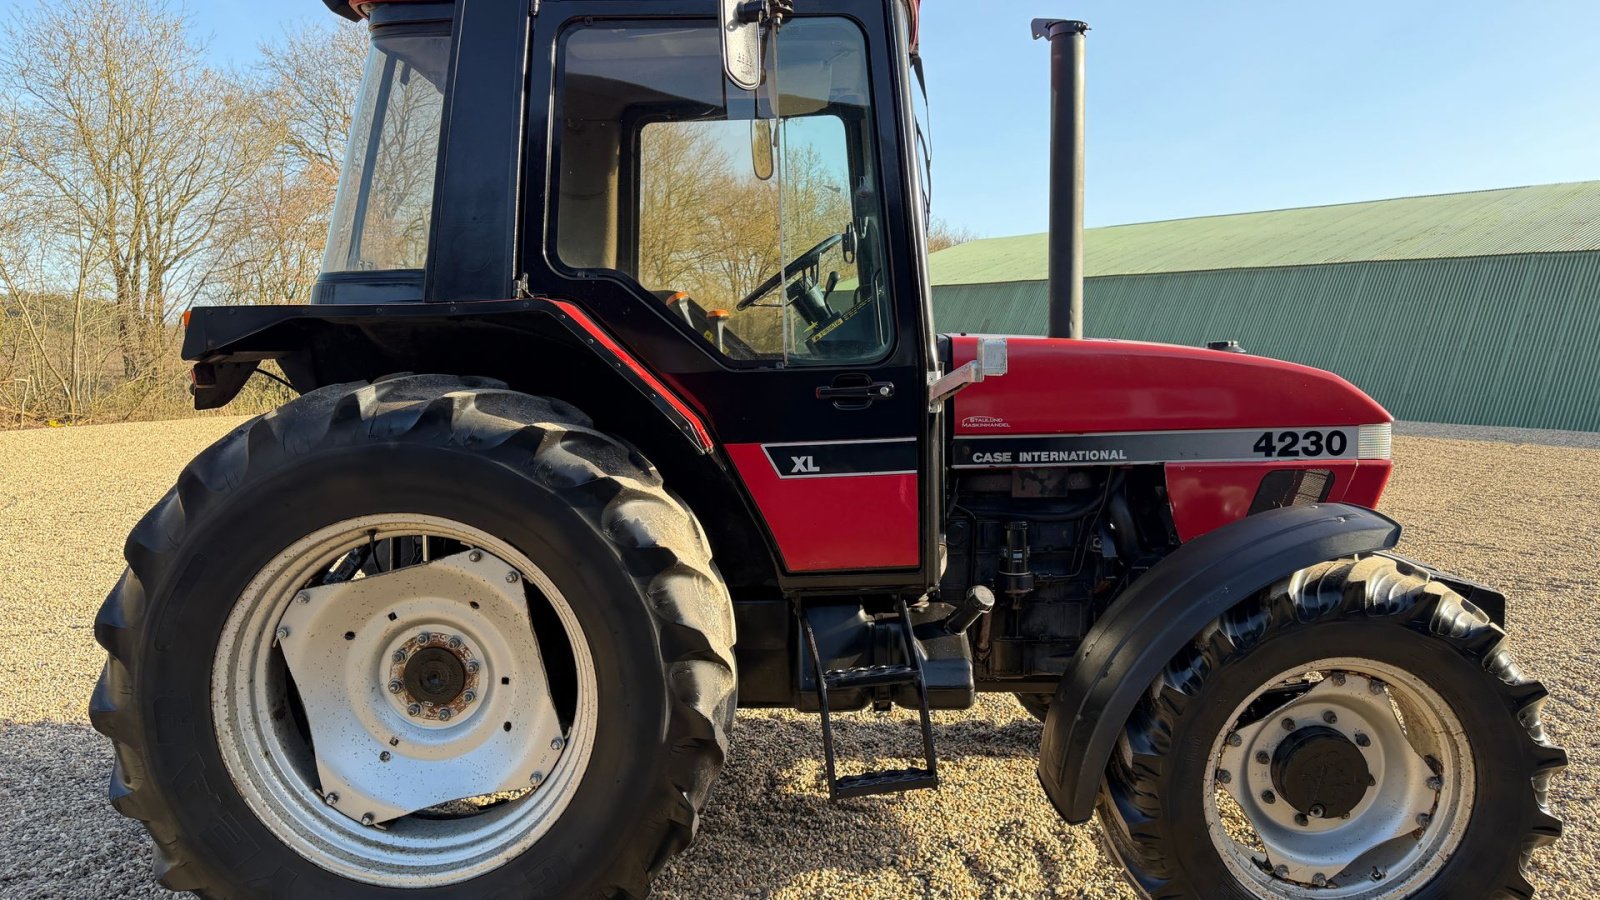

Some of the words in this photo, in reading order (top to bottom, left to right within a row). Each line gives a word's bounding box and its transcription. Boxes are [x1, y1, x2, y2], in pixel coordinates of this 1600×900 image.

[1253, 430, 1347, 457] 4230
[791, 456, 820, 473] XL
[972, 452, 1012, 463] CASE
[1019, 450, 1127, 462] INTERNATIONAL
